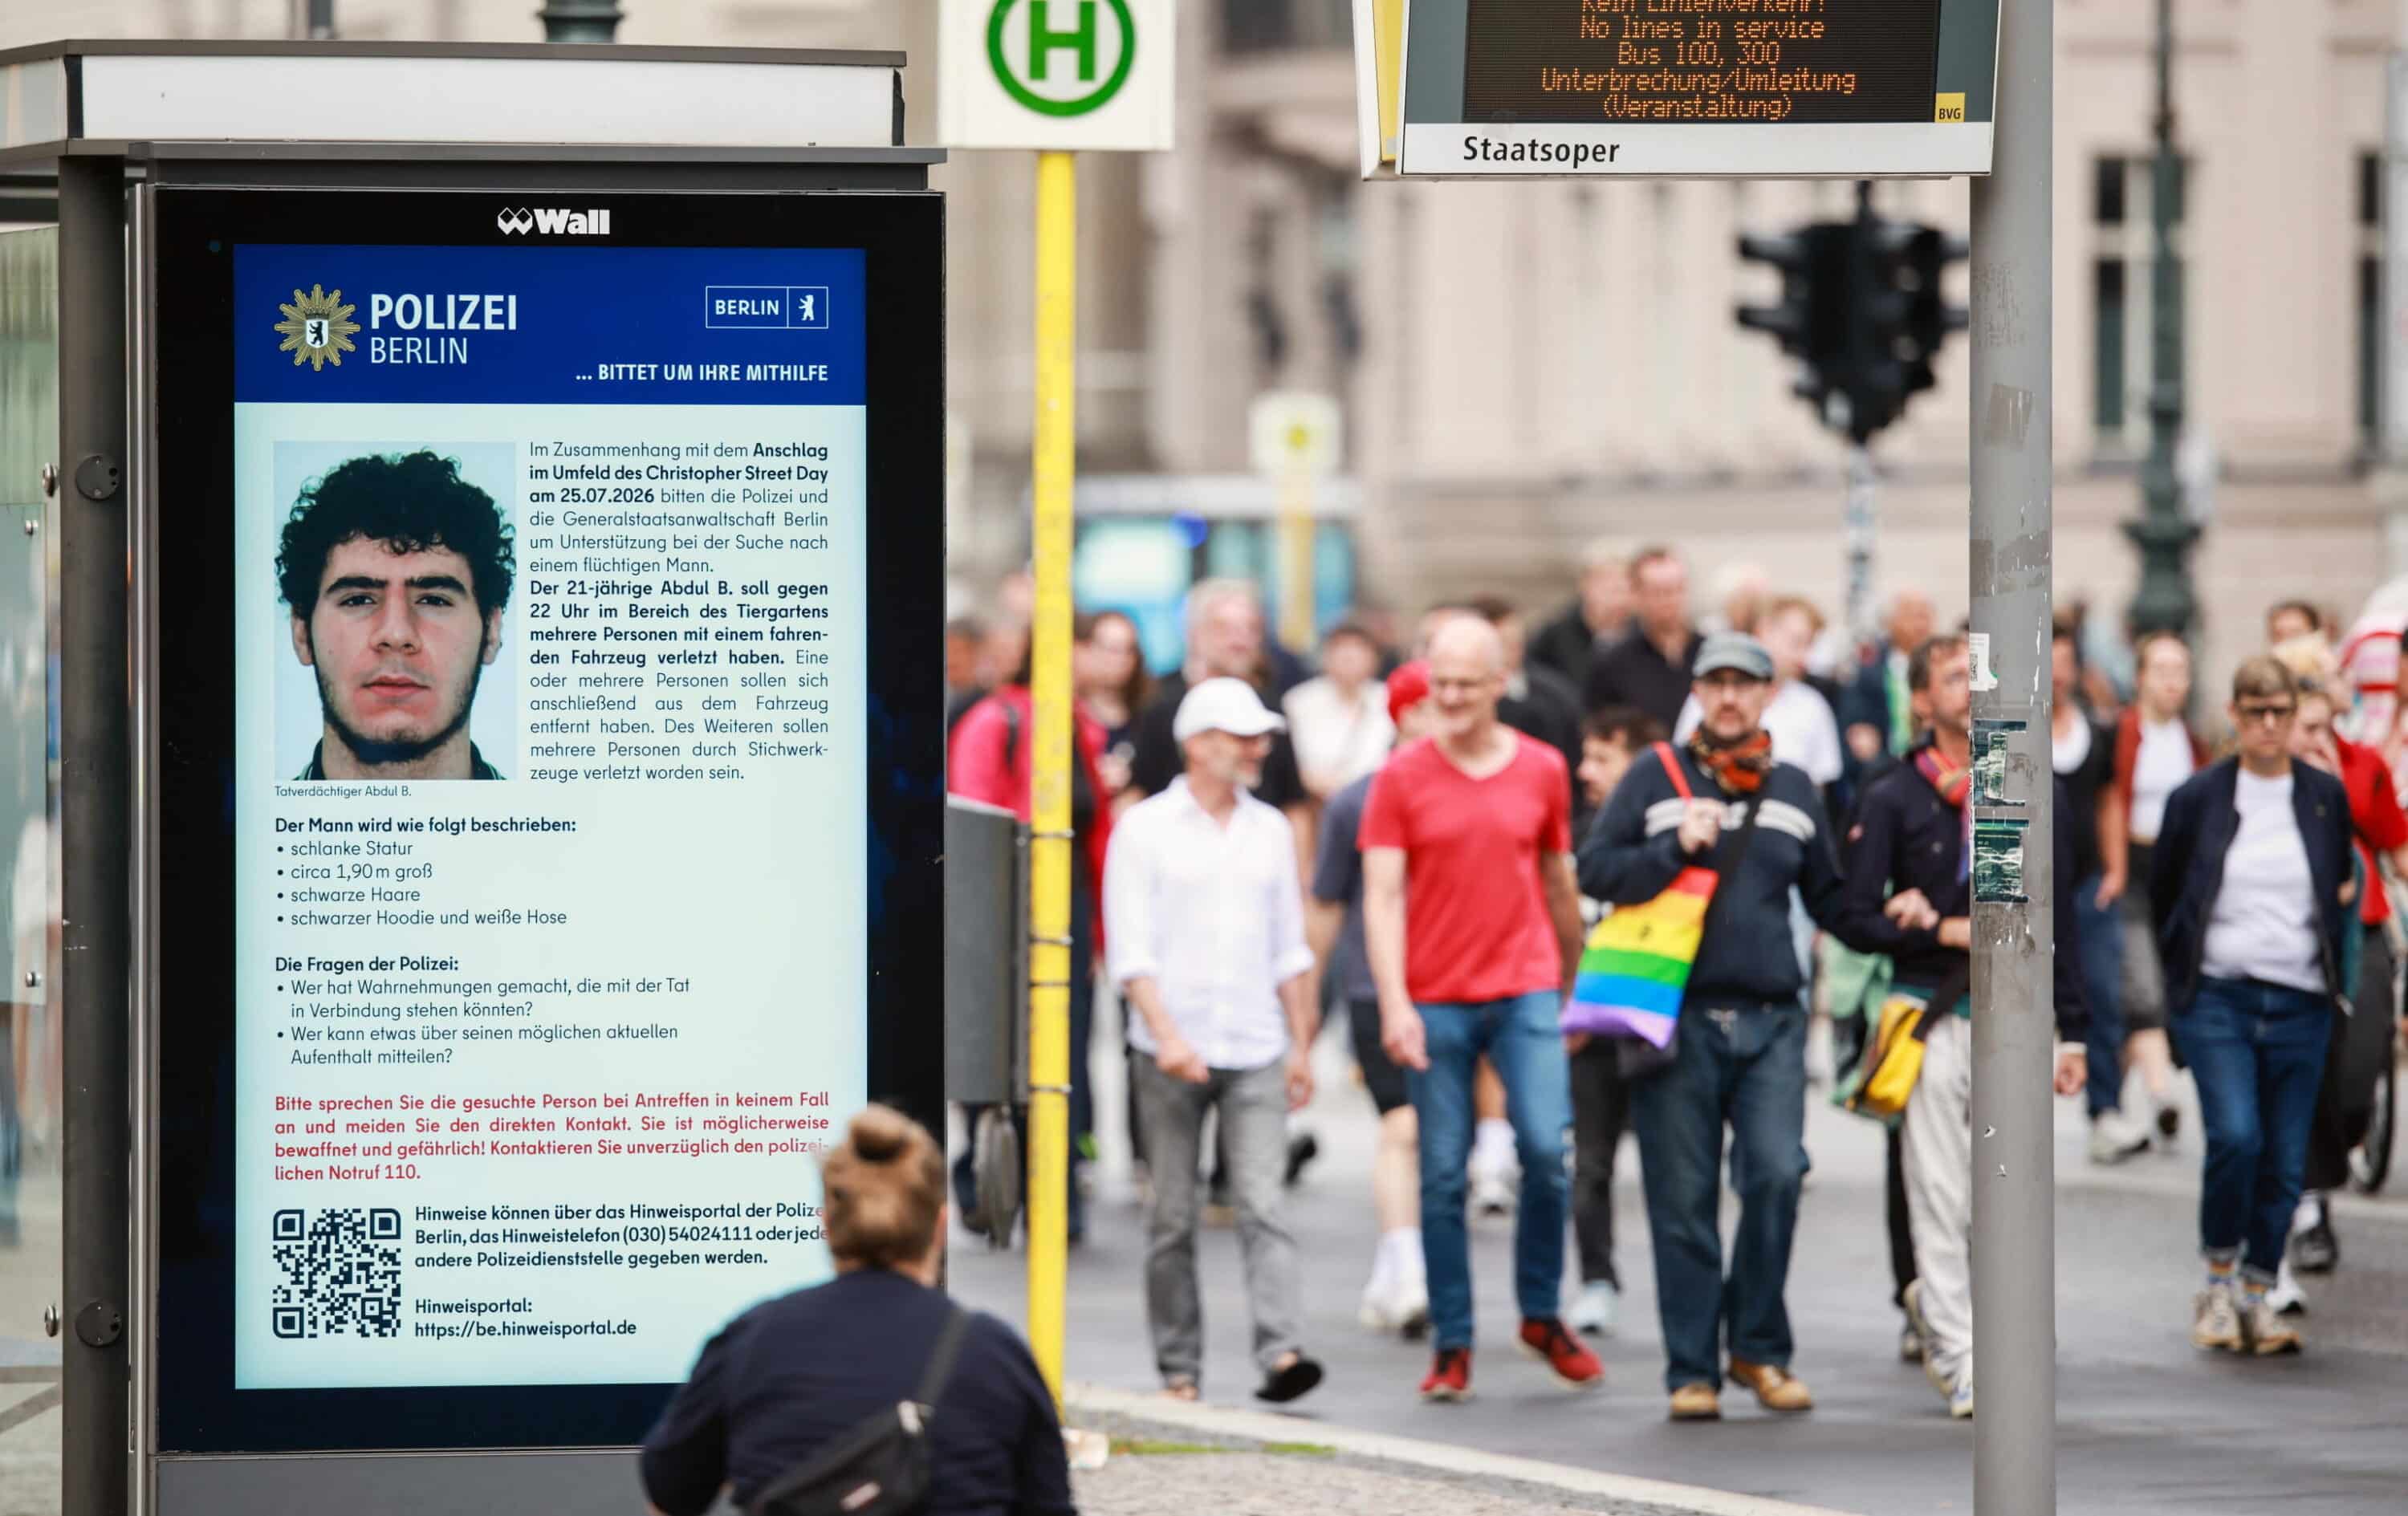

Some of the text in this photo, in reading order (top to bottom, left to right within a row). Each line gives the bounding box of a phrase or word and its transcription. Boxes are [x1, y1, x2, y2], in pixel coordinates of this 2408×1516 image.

[1582, 0, 1635, 12] Kein
[1580, 15, 1824, 39] No lines in service
[1028, 0, 1096, 81] H
[1618, 42, 1780, 67] Bus 100, 300
[1542, 67, 1856, 94] Unterbrechung/Umleitung
[1604, 94, 1792, 120] (Veranstaltung)
[1939, 108, 1961, 120] BVG
[1463, 136, 1620, 169] Staatsoper
[533, 209, 611, 235] Wall
[371, 294, 517, 331] POLIZEI
[714, 299, 779, 315] BERLIN
[371, 337, 468, 364] BERLIN
[598, 364, 658, 380] BITTET
[664, 364, 694, 381] UM
[699, 364, 742, 381] IHRE
[746, 364, 828, 381] MITHILFE
[531, 441, 828, 461] Im Zusammenhang mit dem Anschlag
[529, 464, 828, 485] im Umfeld des Christopher Street Day
[529, 487, 828, 504] am 25.07.2026 bitten die Polizei und
[530, 510, 828, 526] die Generalstaatsanwaltschaft Berlin
[530, 556, 714, 576] einem flüchtigen Mann.
[531, 579, 828, 599] Der 21-jährige Abdul B. soll gegen
[530, 603, 828, 623] 22 Uhr im Bereich des Tiergartens
[530, 648, 828, 669] den Fahrzeug verletzt haben. Eine
[530, 694, 828, 714] anschließend aus dem Fahrzeug
[531, 741, 828, 758] mehrere Personen durch Stichwerk-
[275, 785, 412, 799] Tatverdächtiger Abdul B.
[275, 816, 576, 836] Der Mann wird wie folgt beschrieben:
[291, 840, 413, 856] schlanke Statur
[291, 864, 331, 880] circa
[395, 863, 433, 883] groß
[291, 886, 421, 902] schwarze Haare
[291, 908, 567, 925] schwarzer Hoodie und weiße Hose
[275, 955, 458, 975] Die Fragen der Polizei:
[291, 977, 689, 998] Wer hat Wahrnehmungen gemacht, die mit der Tat
[291, 1047, 453, 1064] Aufenthalt mitteilen?
[275, 1091, 829, 1114] Bitte sprechen Sie die gesuchte Person bei Antreffen in keinem Fall
[275, 1141, 358, 1158] bewaffnet
[362, 1140, 393, 1157] und
[397, 1140, 486, 1160] gefährlich!
[490, 1139, 592, 1156] Kontaktieren
[597, 1138, 623, 1155] Sie
[626, 1137, 730, 1157] unverzüglich
[734, 1137, 763, 1153] den
[275, 1164, 421, 1181] lichen Notruf 110.
[416, 1202, 824, 1222] Hinweise können über das Hinweisportal der Polize
[416, 1228, 467, 1247] Berlin,
[469, 1228, 499, 1245] das
[502, 1226, 620, 1244] Hinweistelefon
[623, 1225, 666, 1246] (030)
[668, 1226, 753, 1242] 54024111
[755, 1225, 791, 1241] oder
[414, 1248, 768, 1270] andere Polizeidienststelle gegeben werden.
[415, 1297, 532, 1317] Hinweisportal:
[415, 1319, 637, 1341] https://be.hinweisportal.de
